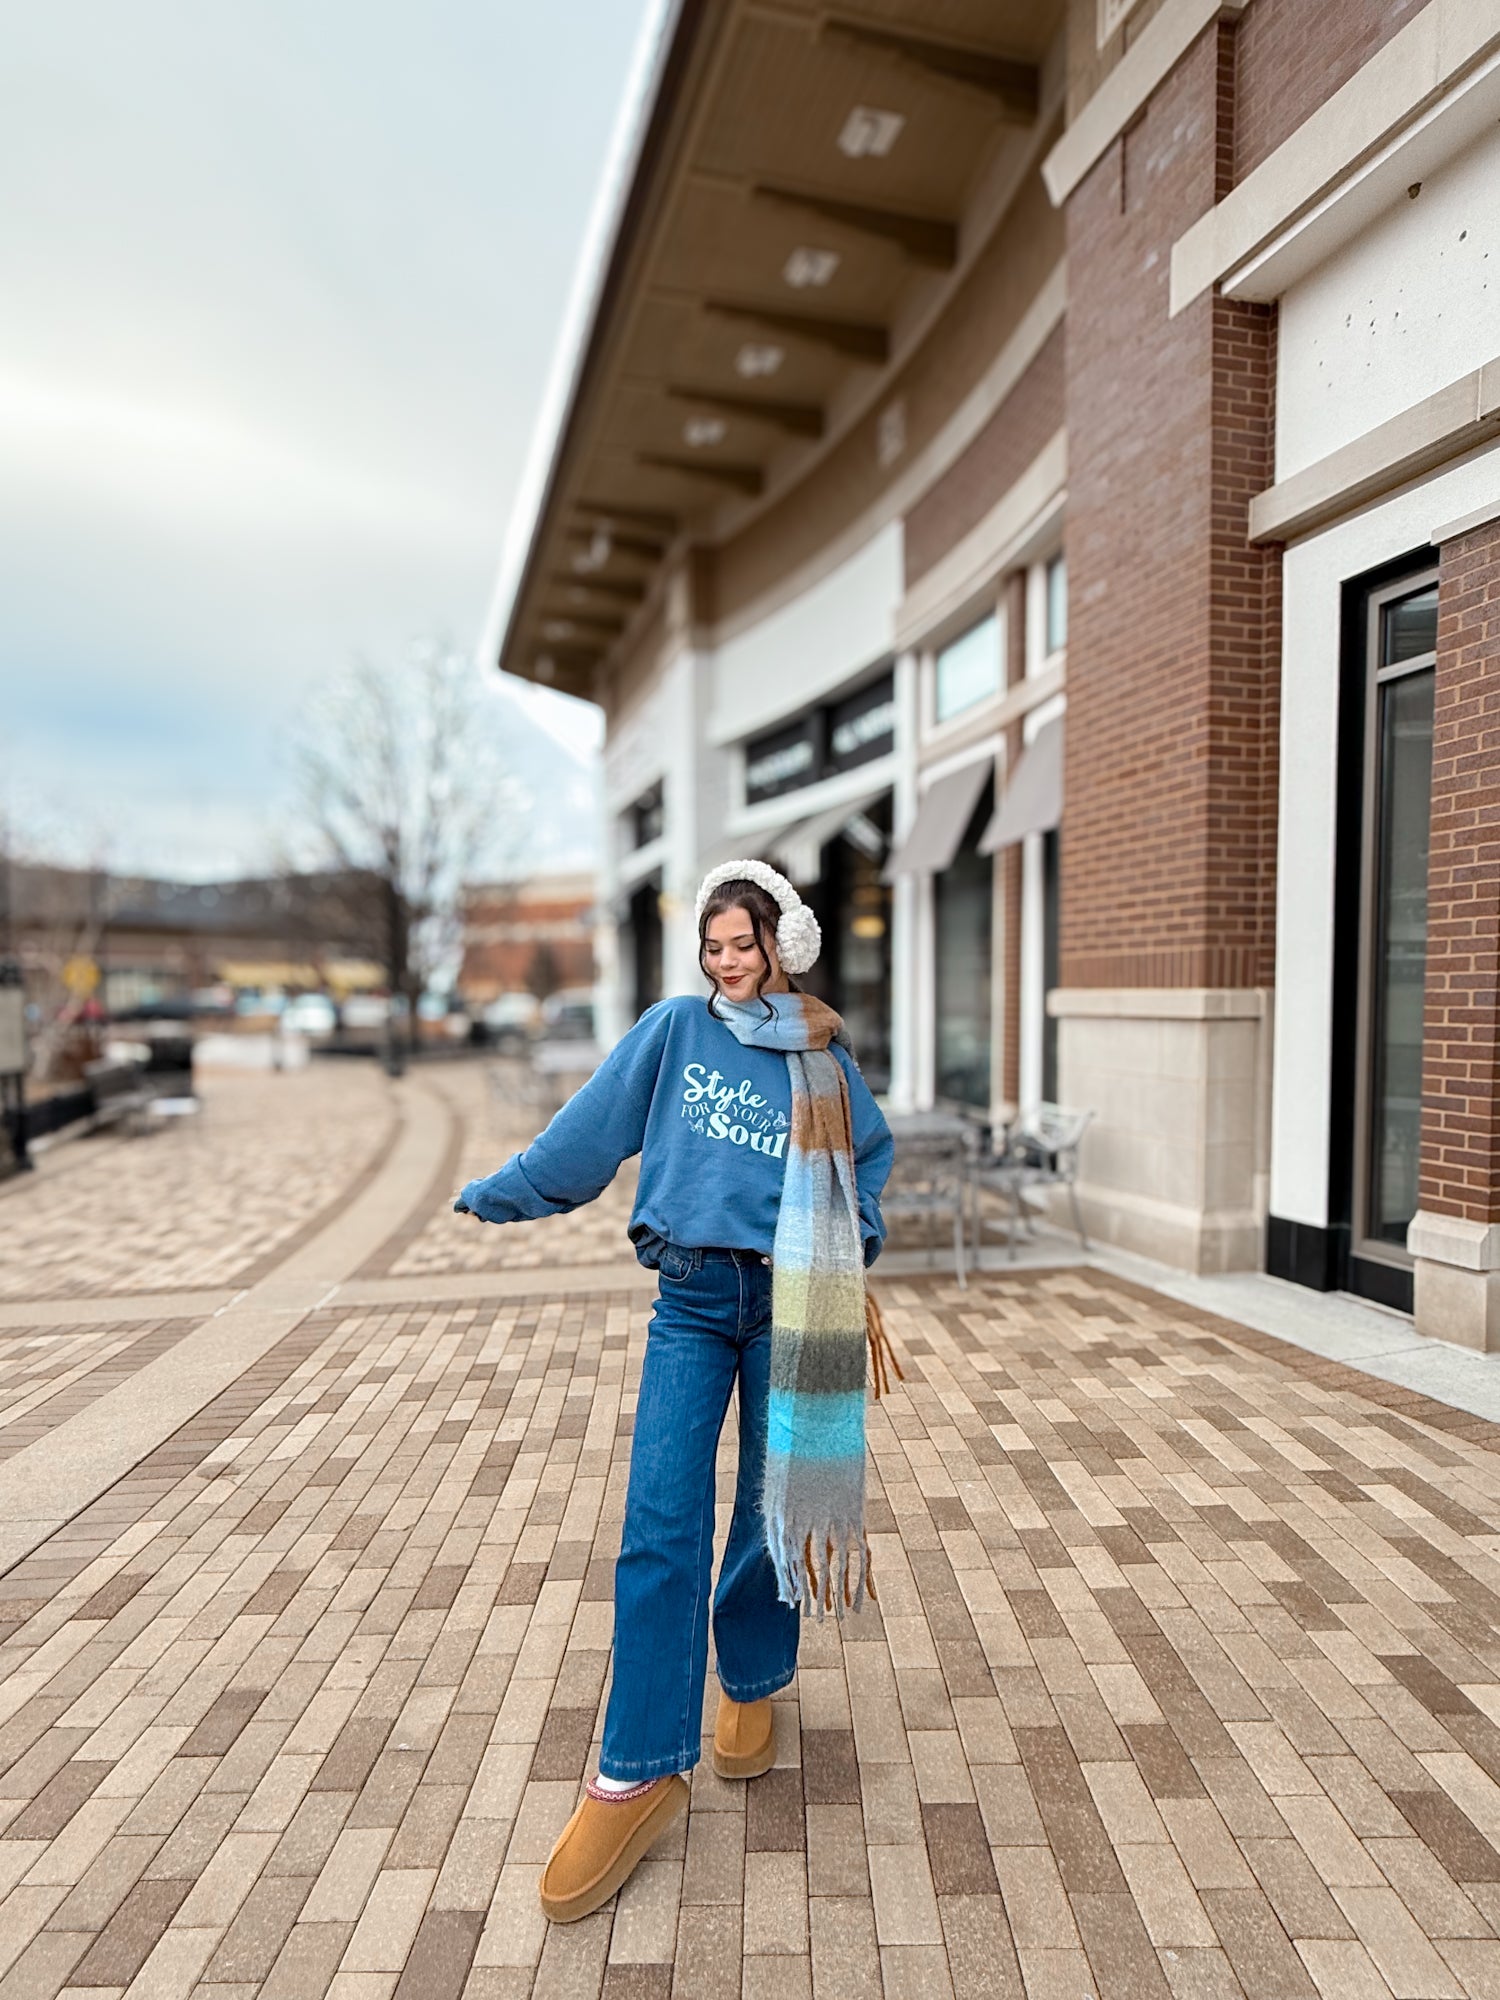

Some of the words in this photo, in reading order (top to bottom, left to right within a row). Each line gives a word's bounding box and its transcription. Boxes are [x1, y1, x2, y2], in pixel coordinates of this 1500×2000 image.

[683, 1063, 768, 1112] Style
[681, 1102, 711, 1118] FOR
[732, 1104, 772, 1133] YOUR
[706, 1112, 788, 1159] Soul
